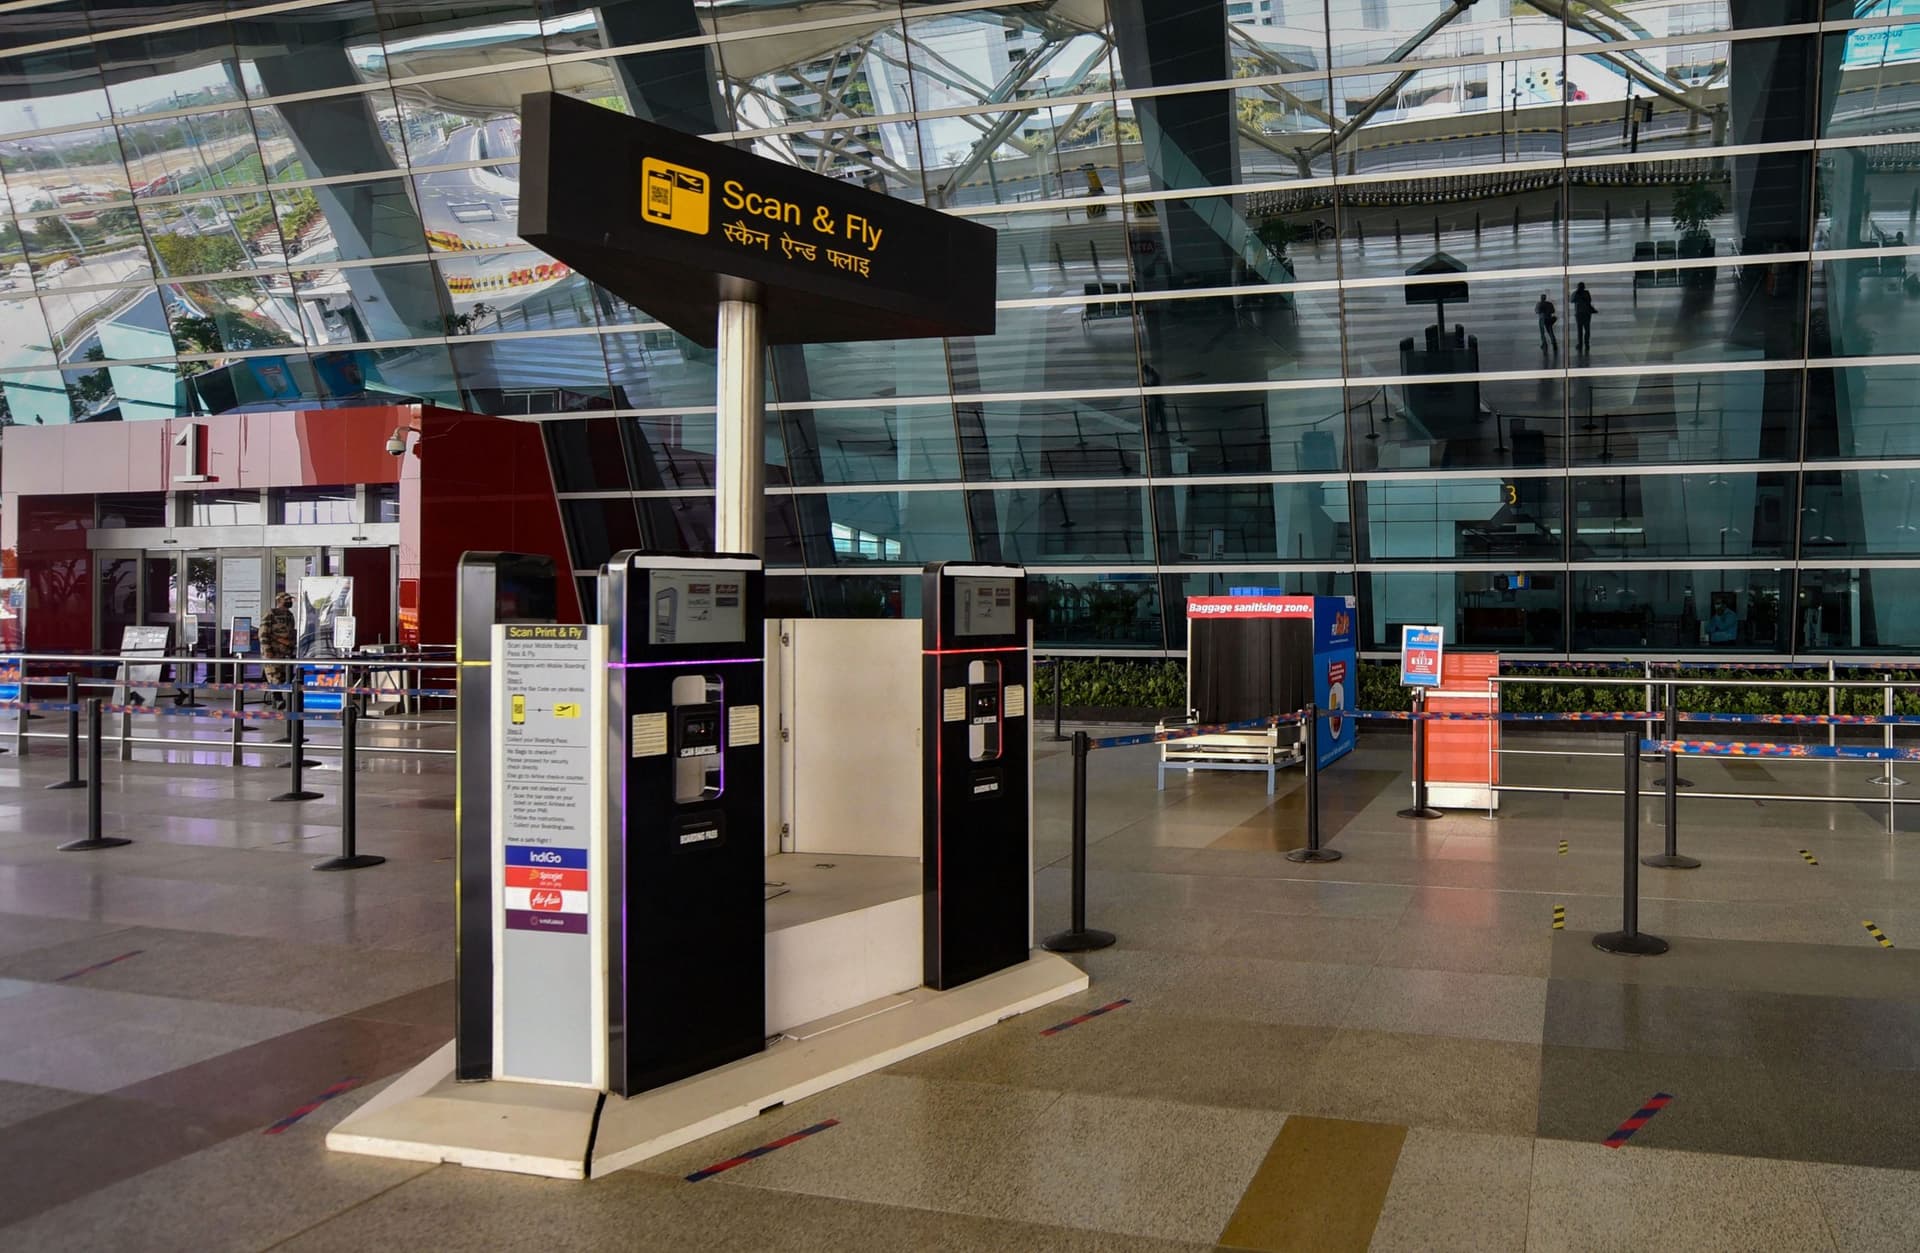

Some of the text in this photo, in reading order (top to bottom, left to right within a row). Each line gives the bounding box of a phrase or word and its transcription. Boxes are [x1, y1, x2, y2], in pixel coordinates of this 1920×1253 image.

[722, 180, 883, 250] Scan & Fly
[722, 220, 871, 278] स्कैन ऐन्ड फ्लाइ
[174, 423, 207, 482] 1
[1189, 603, 1232, 614] Baggage
[1234, 602, 1283, 614] sanitising
[510, 627, 583, 638] Scan Print & Fly
[530, 851, 562, 863] IndiGo
